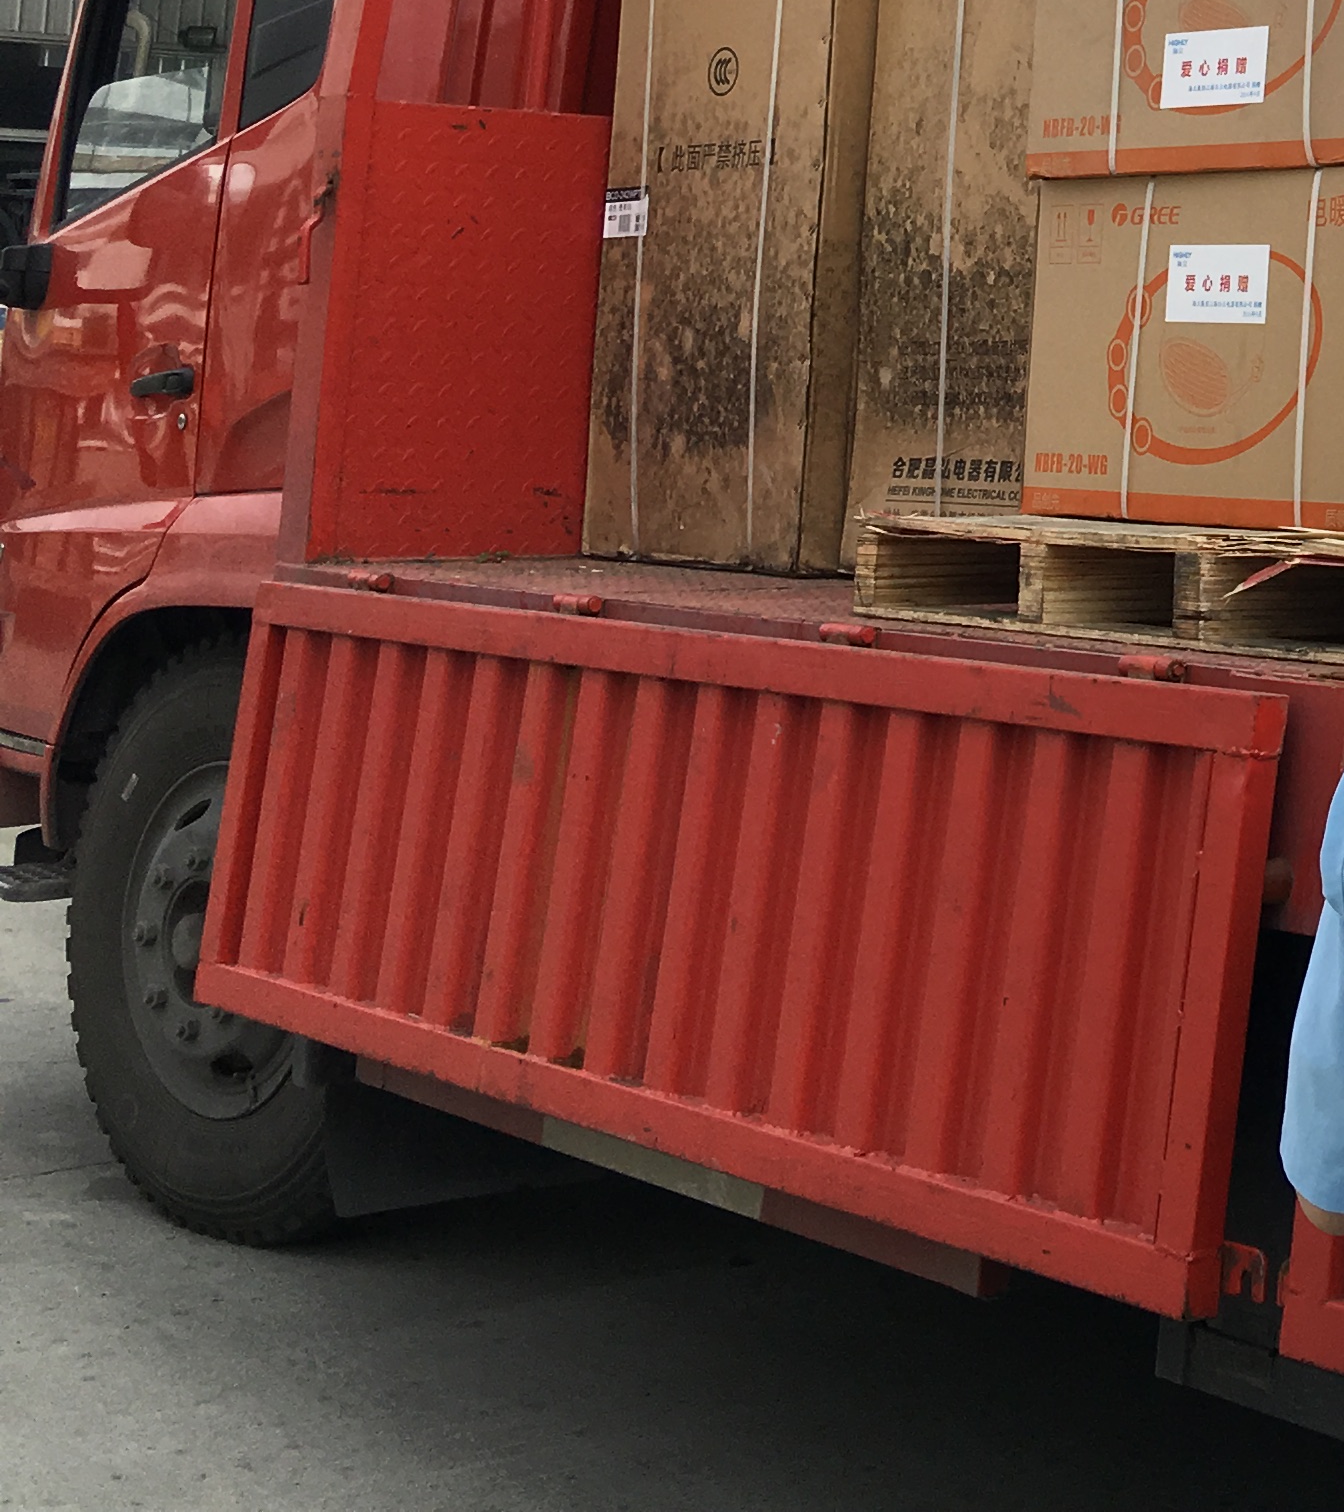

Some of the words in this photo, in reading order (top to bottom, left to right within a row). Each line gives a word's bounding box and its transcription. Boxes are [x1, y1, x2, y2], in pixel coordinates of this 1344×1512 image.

[1180, 55, 1248, 78] 爱心捐赠
[1184, 274, 1250, 293] 爱心捐赠
[1035, 452, 1108, 476] NBFB-20-WG
[956, 489, 1006, 501] ELECTRICAL
